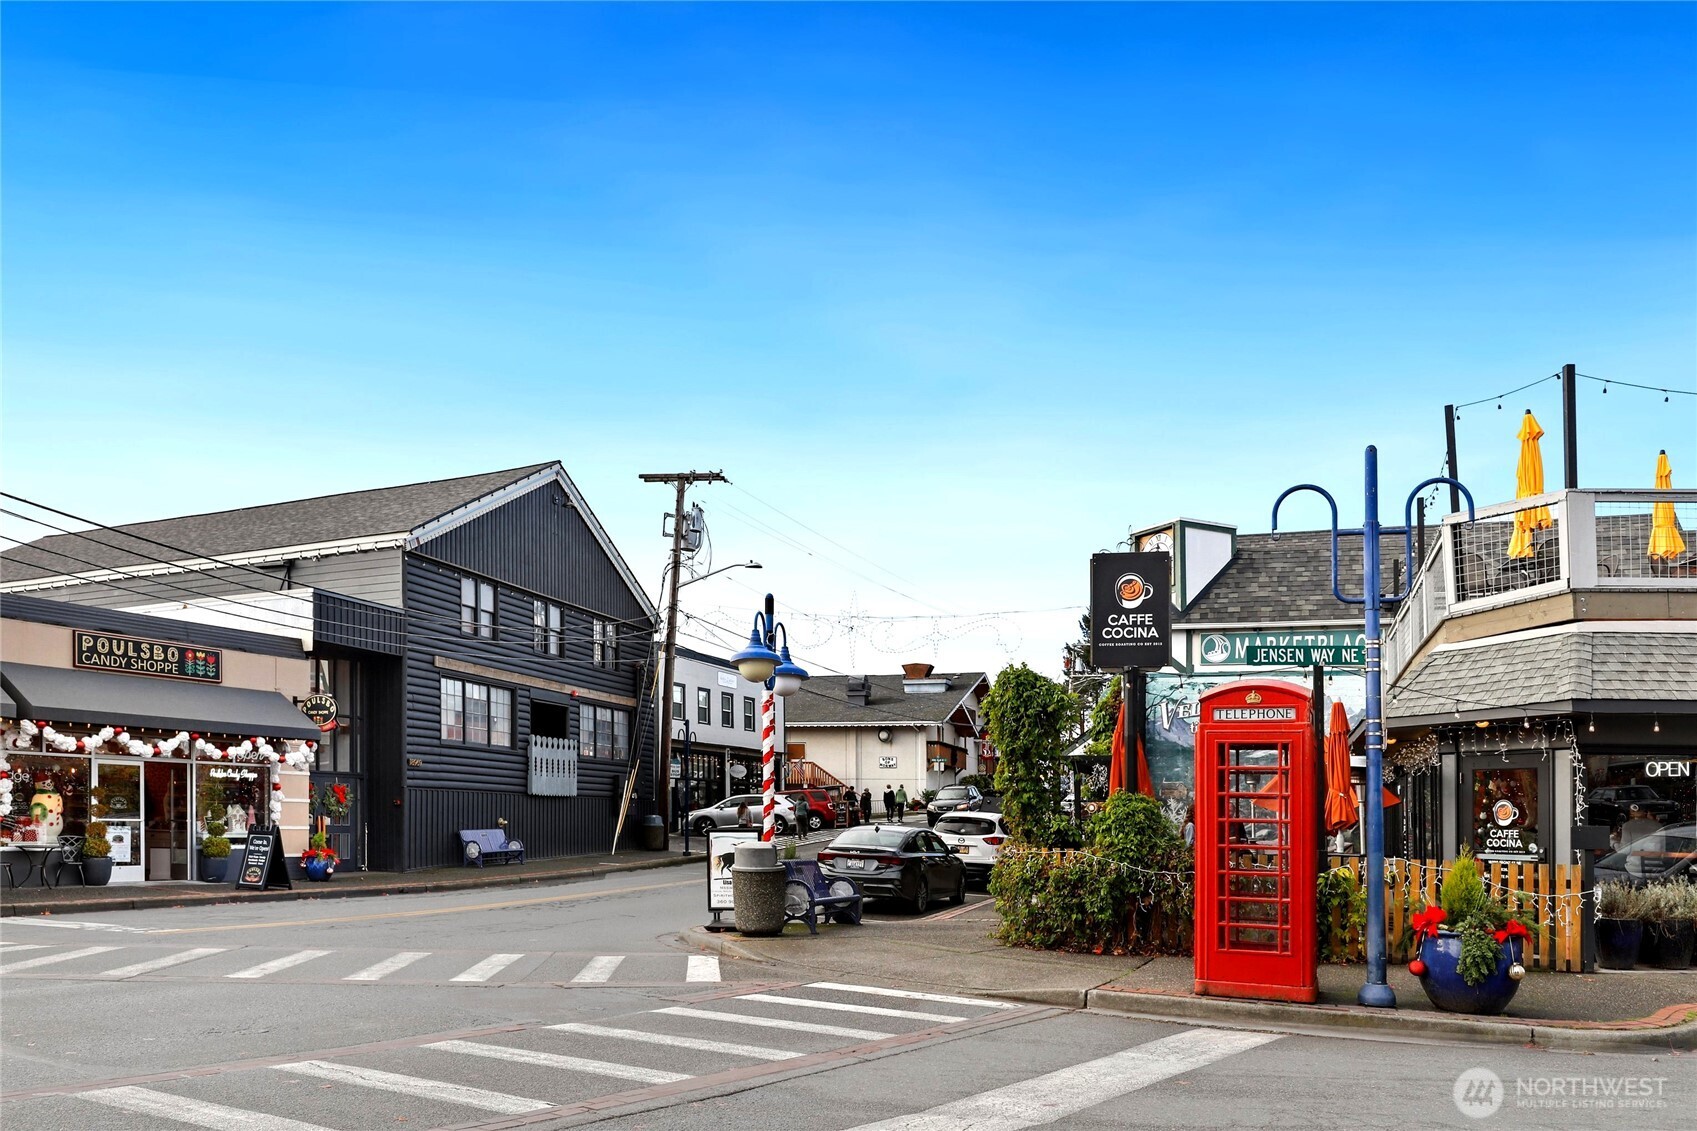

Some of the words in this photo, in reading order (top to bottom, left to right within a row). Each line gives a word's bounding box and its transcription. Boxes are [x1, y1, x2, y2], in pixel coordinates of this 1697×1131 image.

[1107, 613, 1153, 626] CAFFE
[1102, 626, 1159, 639] COCINA
[81, 635, 179, 663] POULSBO
[1253, 648, 1304, 663] JENSEN
[1310, 648, 1335, 663] WAY
[1341, 648, 1359, 663] NE
[82, 652, 127, 668] CANDY
[130, 658, 179, 675] SHOPPE
[302, 696, 335, 713] POULSBO
[1216, 708, 1292, 719] TELEPHONE
[1645, 761, 1690, 777] OPEN
[1490, 829, 1519, 838] CAFFE
[1486, 838, 1523, 848] COCINA
